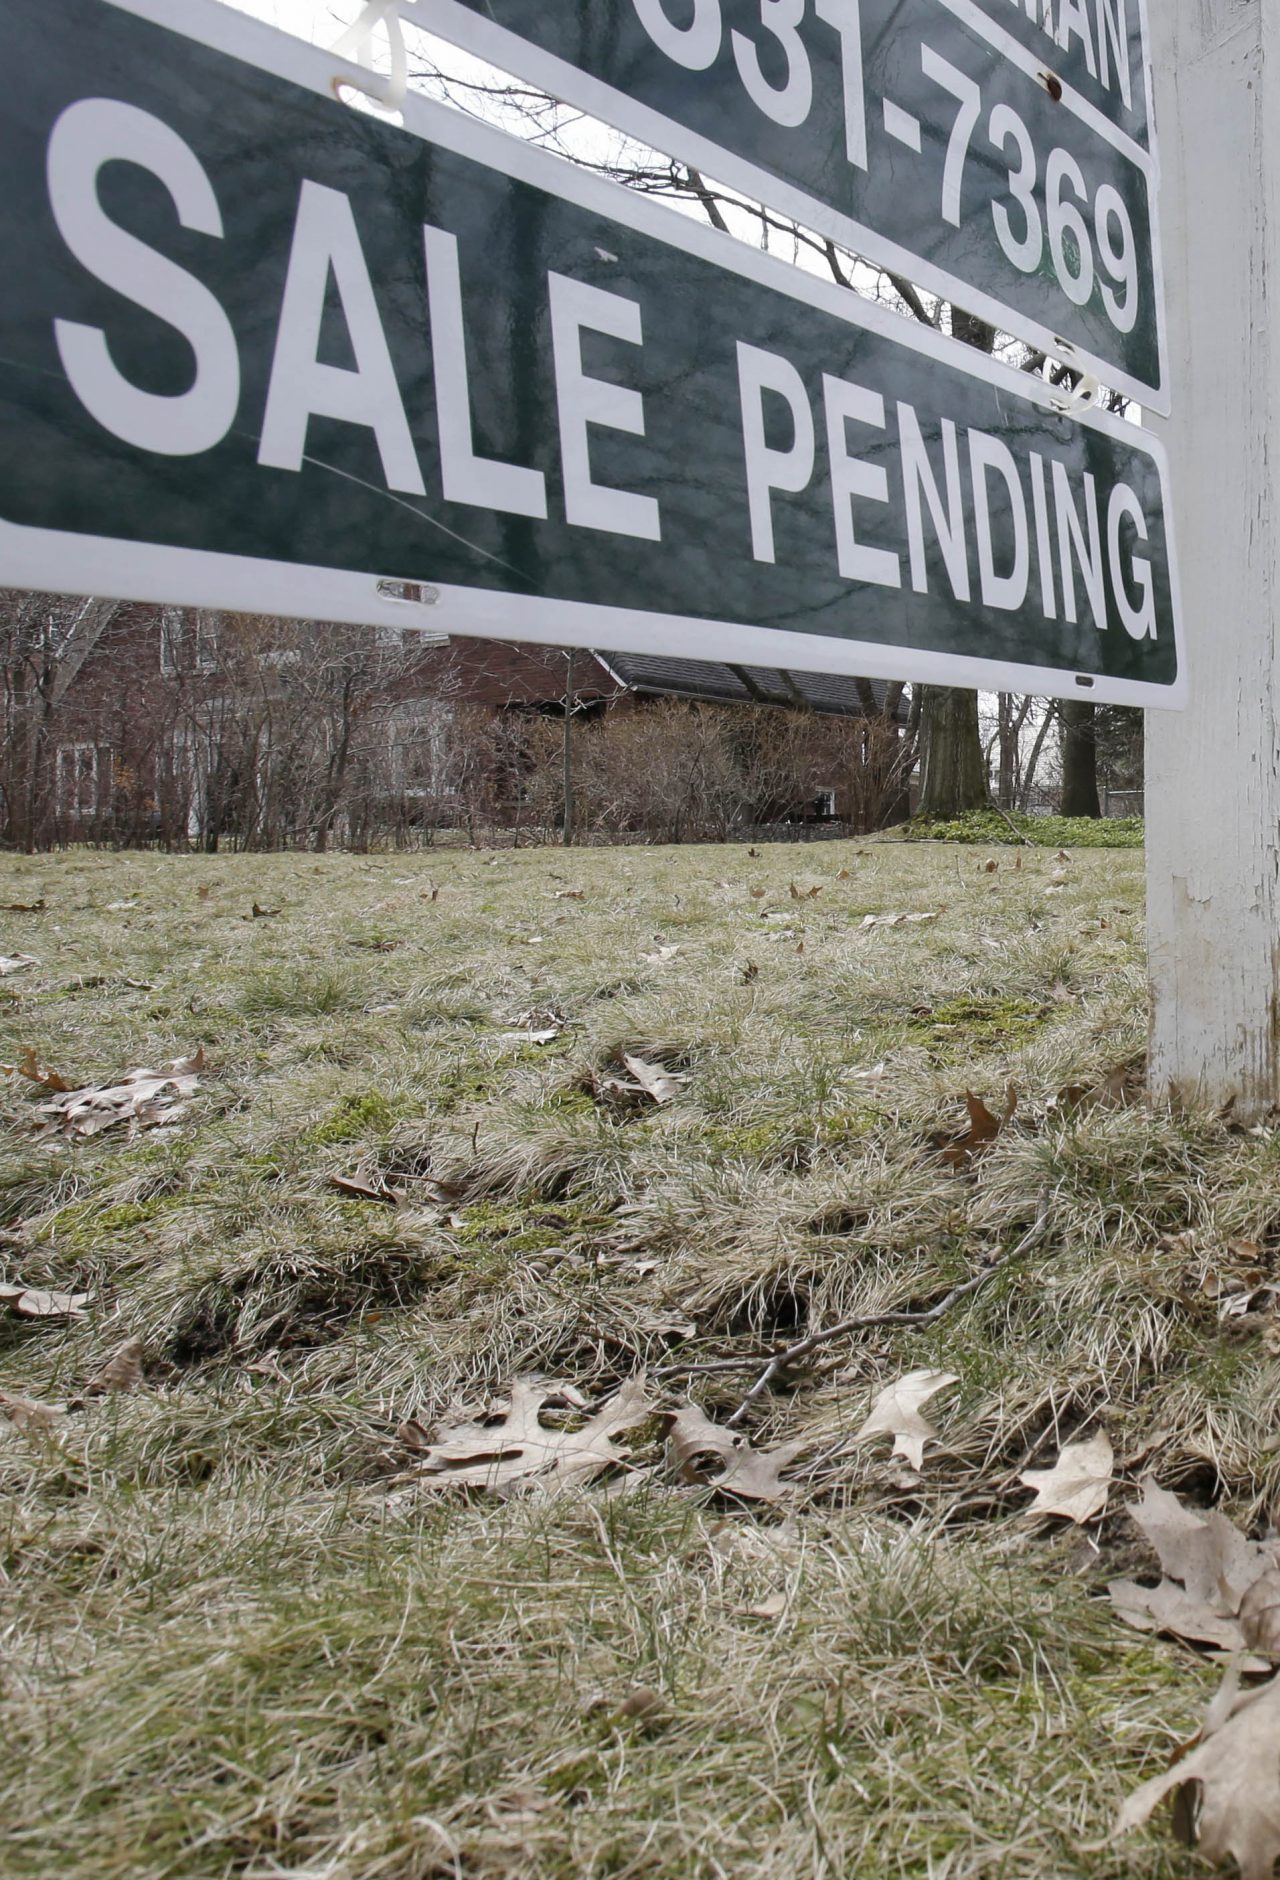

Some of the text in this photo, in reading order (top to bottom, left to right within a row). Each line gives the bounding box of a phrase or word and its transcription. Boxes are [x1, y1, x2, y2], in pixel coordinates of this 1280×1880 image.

[1006, 0, 1133, 113] AN
[47, 98, 1158, 641] SALE PENDING
